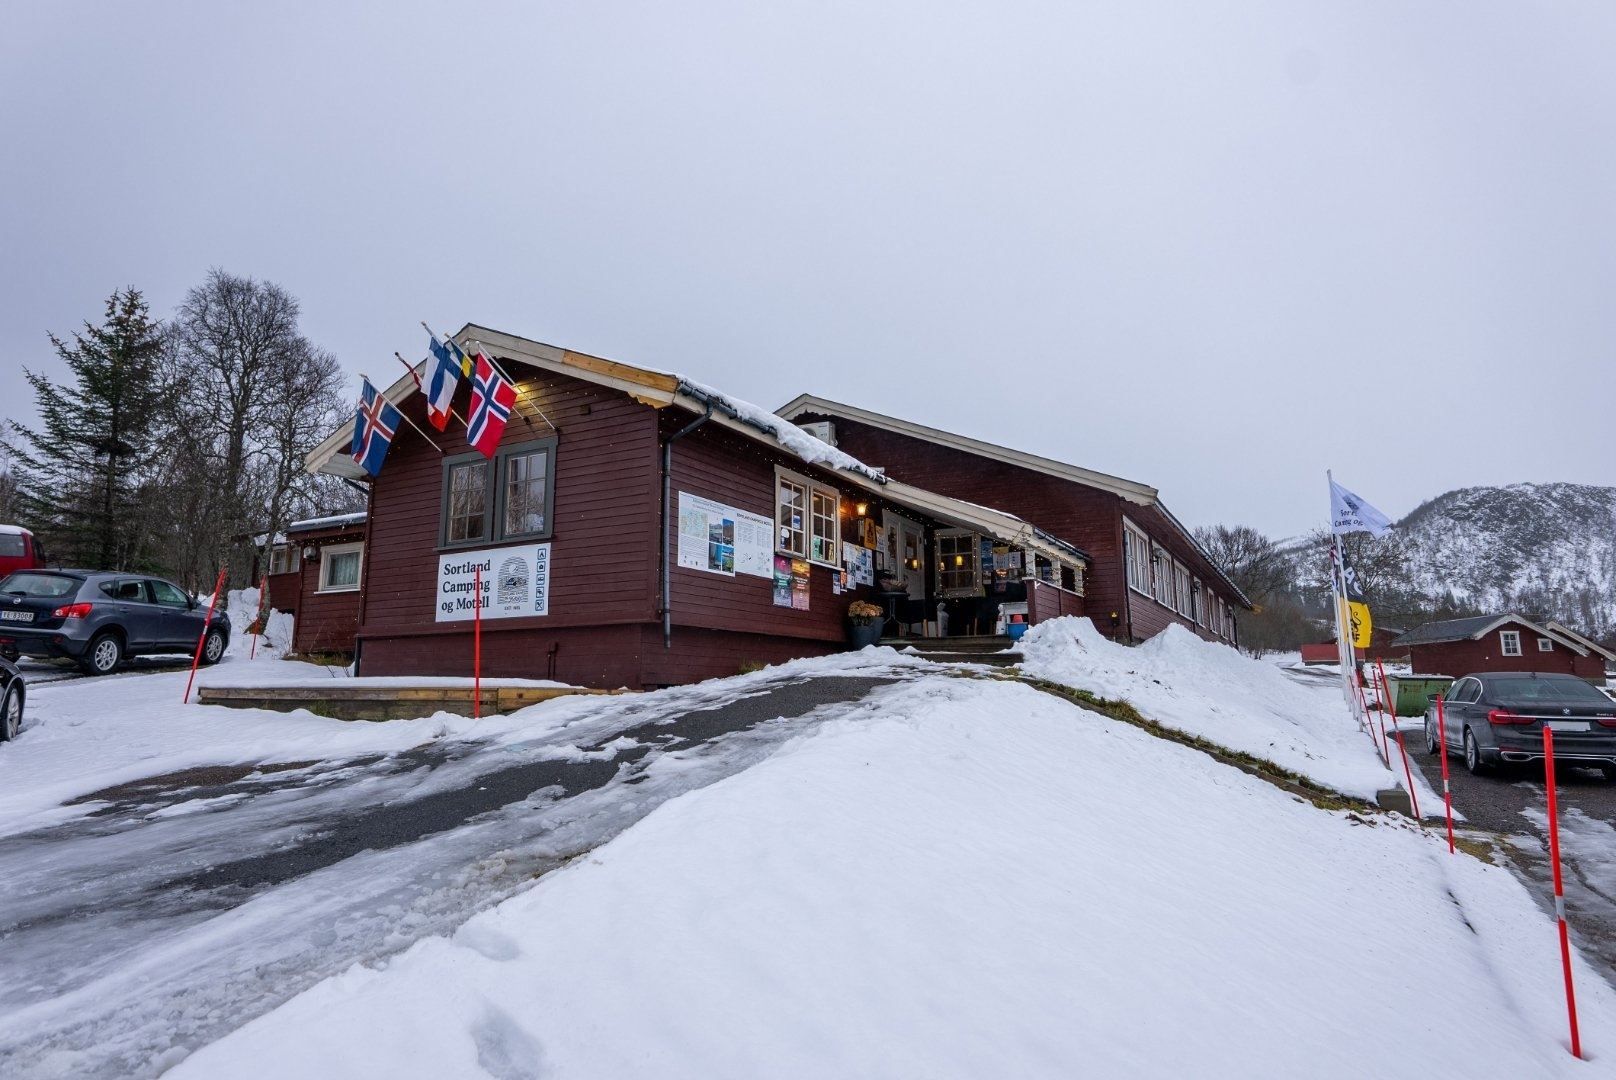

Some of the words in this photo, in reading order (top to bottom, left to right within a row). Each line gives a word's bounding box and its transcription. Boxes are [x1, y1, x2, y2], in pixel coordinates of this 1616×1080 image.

[443, 558, 491, 576] Sortland
[442, 578, 491, 594] Camping
[441, 601, 454, 614] og
[456, 595, 490, 610] Motell
